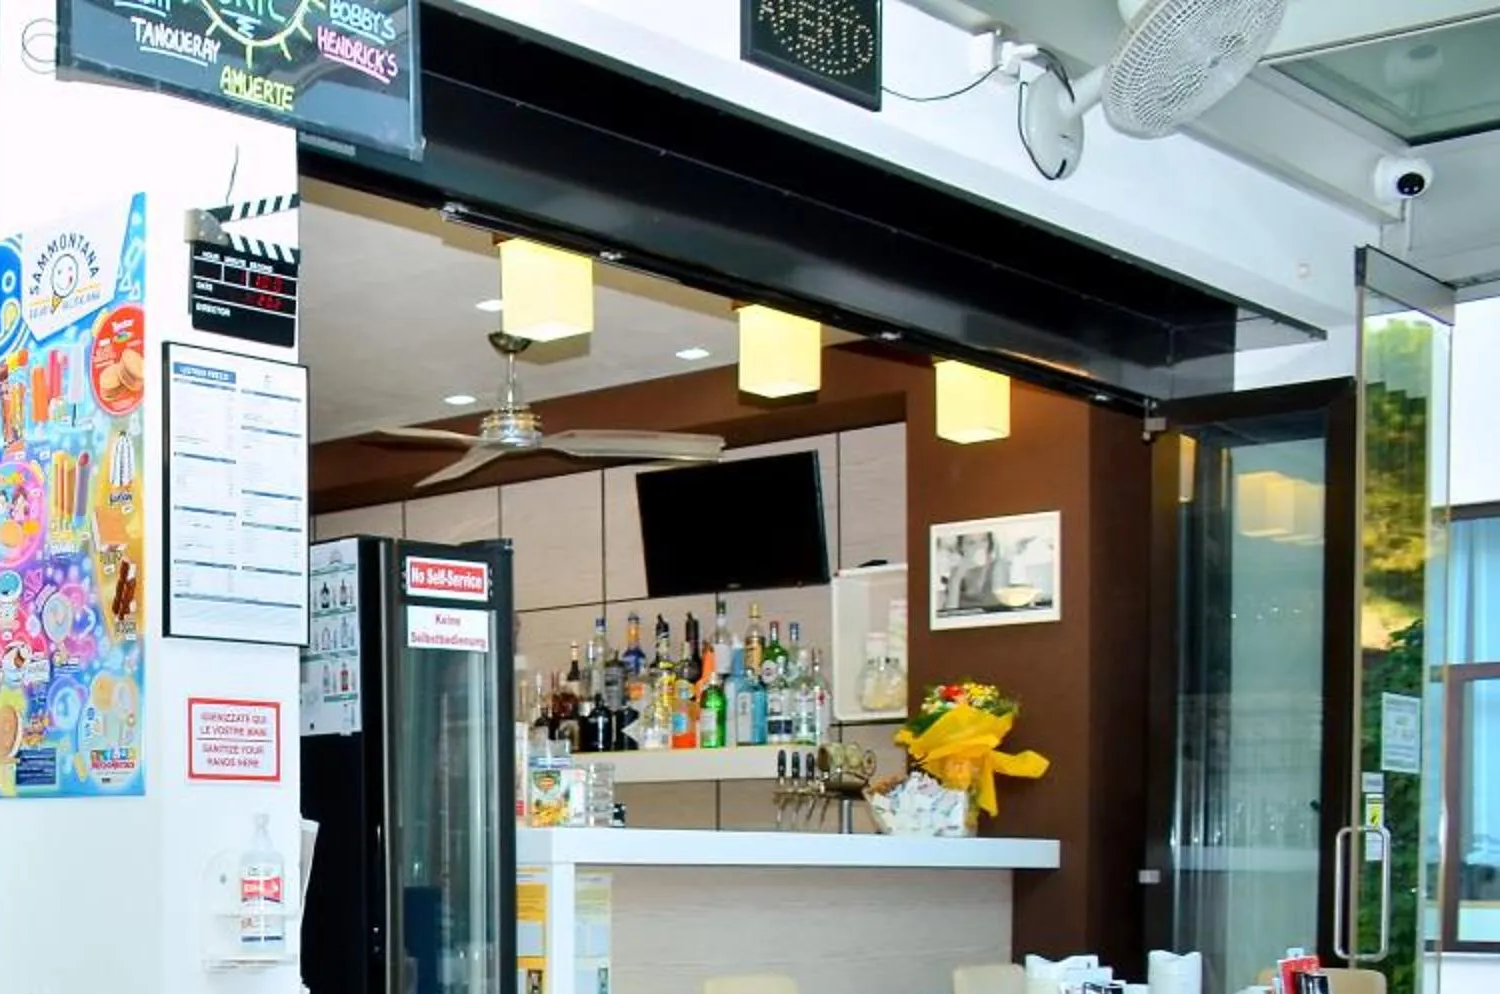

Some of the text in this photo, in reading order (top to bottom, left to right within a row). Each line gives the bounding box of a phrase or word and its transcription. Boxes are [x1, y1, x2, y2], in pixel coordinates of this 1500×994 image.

[130, 16, 222, 65] TANQUERAY
[329, 0, 397, 40] BOBBY'S
[317, 25, 399, 78] HENDRICK'S
[220, 65, 295, 109] AMUERTE
[29, 231, 101, 296] SAMMONTANA
